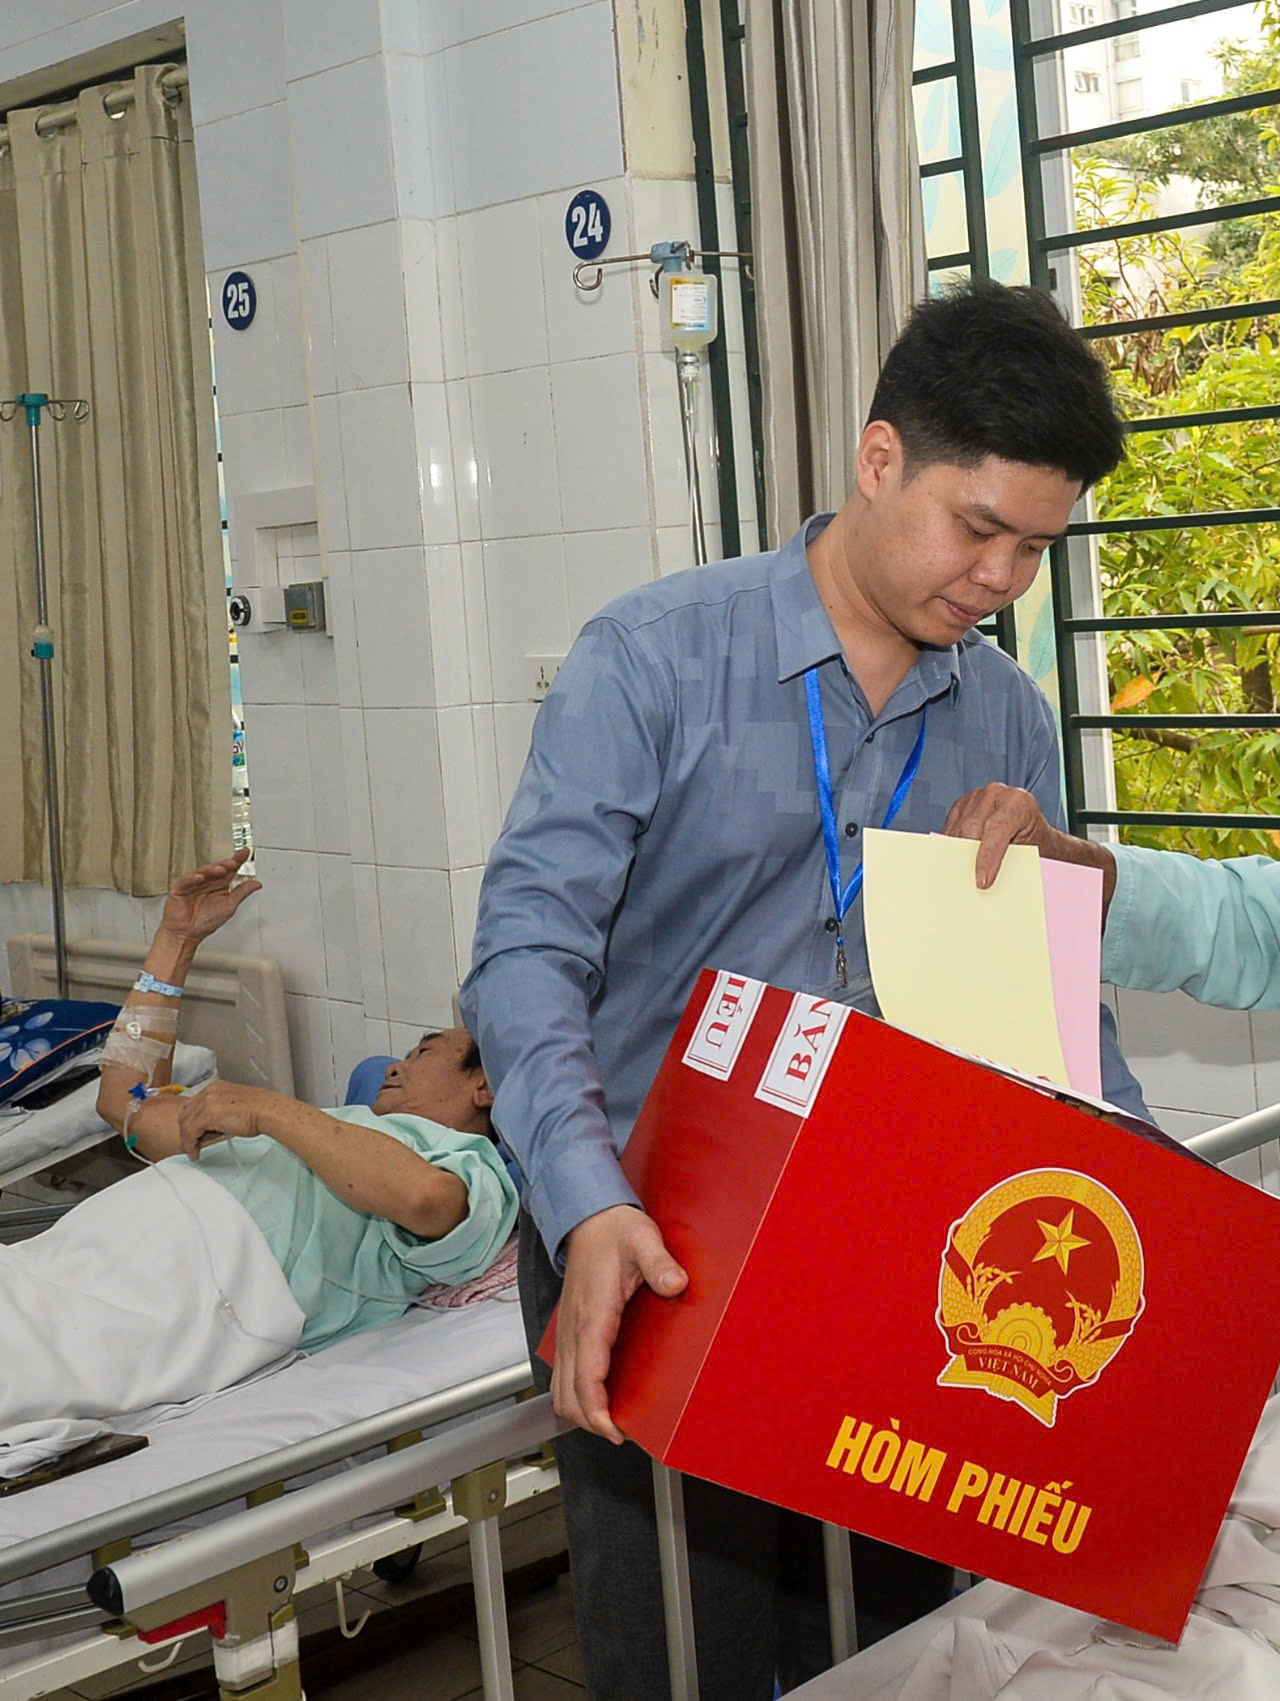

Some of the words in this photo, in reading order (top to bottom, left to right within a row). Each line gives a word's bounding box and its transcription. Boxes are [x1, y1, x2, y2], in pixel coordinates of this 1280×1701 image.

[571, 203, 604, 248] 24
[226, 282, 250, 319] 25
[705, 977, 747, 1049] IẾU
[785, 998, 834, 1083] BĂN
[979, 1355, 1008, 1373] VIỆT
[1012, 1363, 1039, 1389] NAM
[825, 1415, 947, 1503] HÒM
[946, 1460, 1093, 1554] PHIẾU
